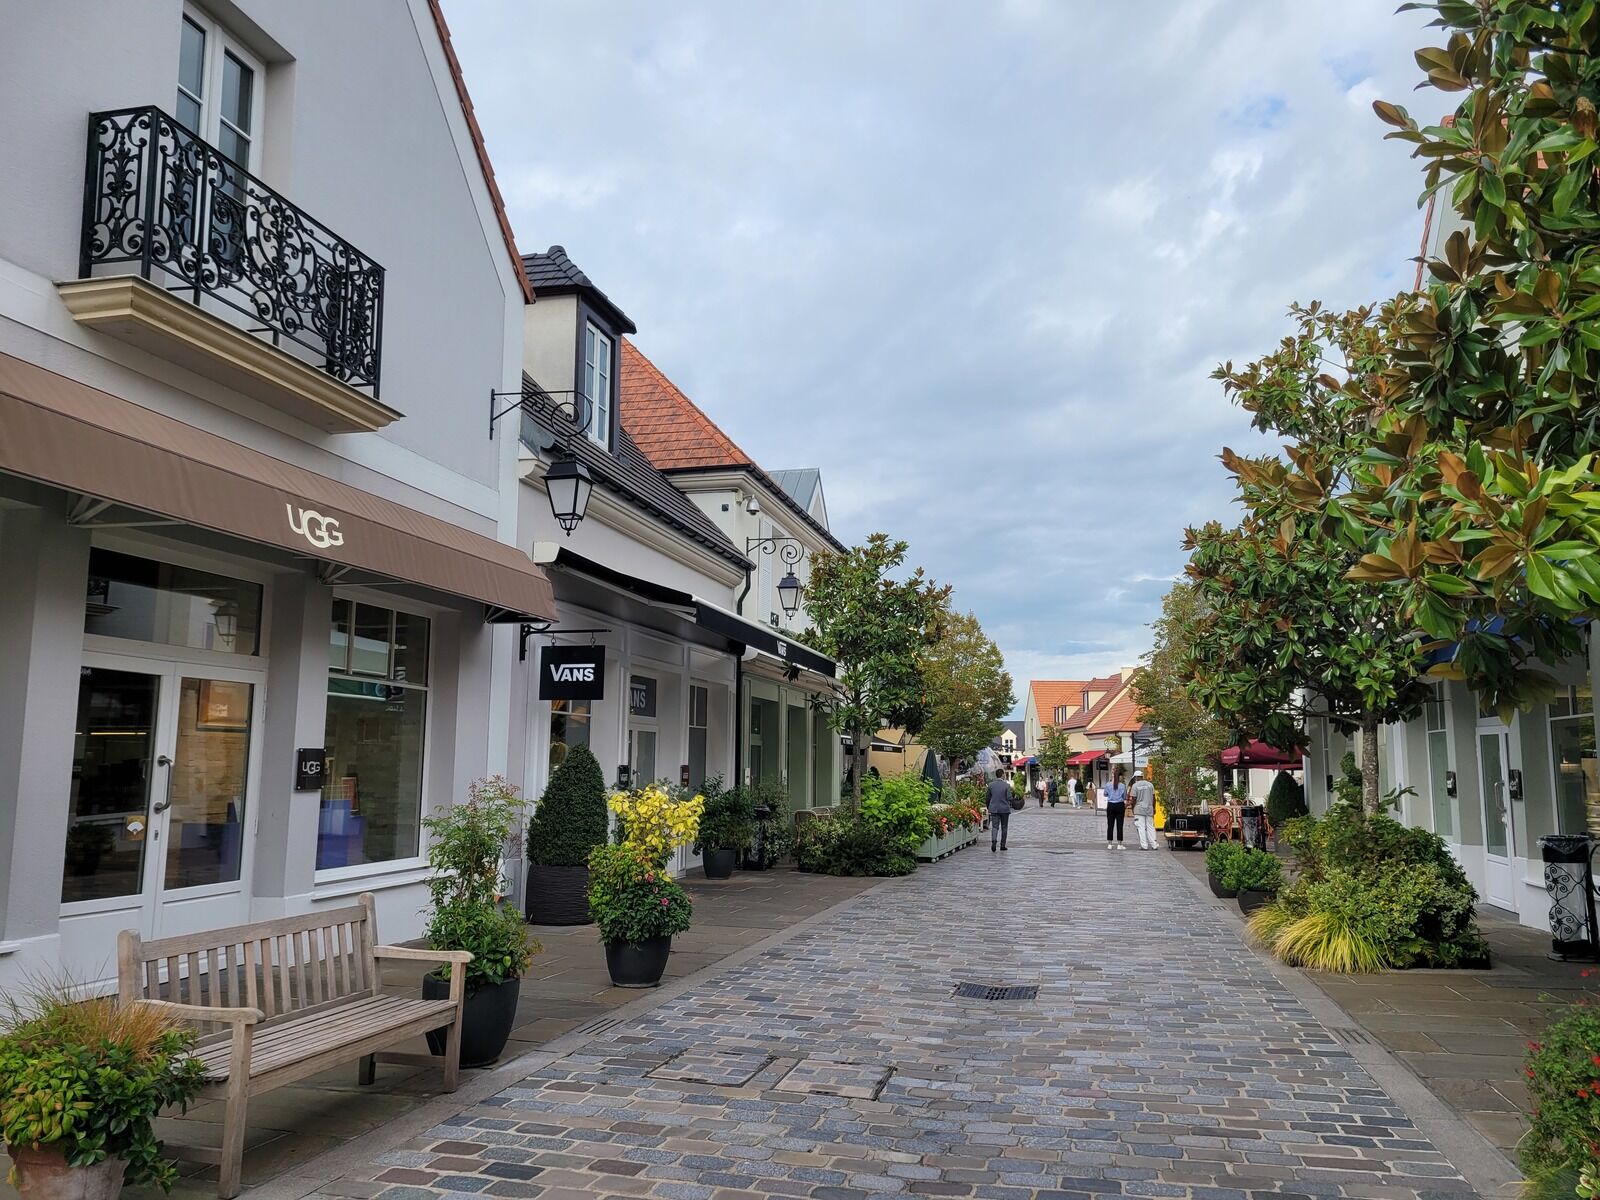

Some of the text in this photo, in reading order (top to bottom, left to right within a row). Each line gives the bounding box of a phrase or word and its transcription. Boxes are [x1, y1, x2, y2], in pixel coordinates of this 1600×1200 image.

[286, 503, 344, 548] UGG
[549, 663, 595, 682] VANS
[302, 761, 321, 774] UGG
